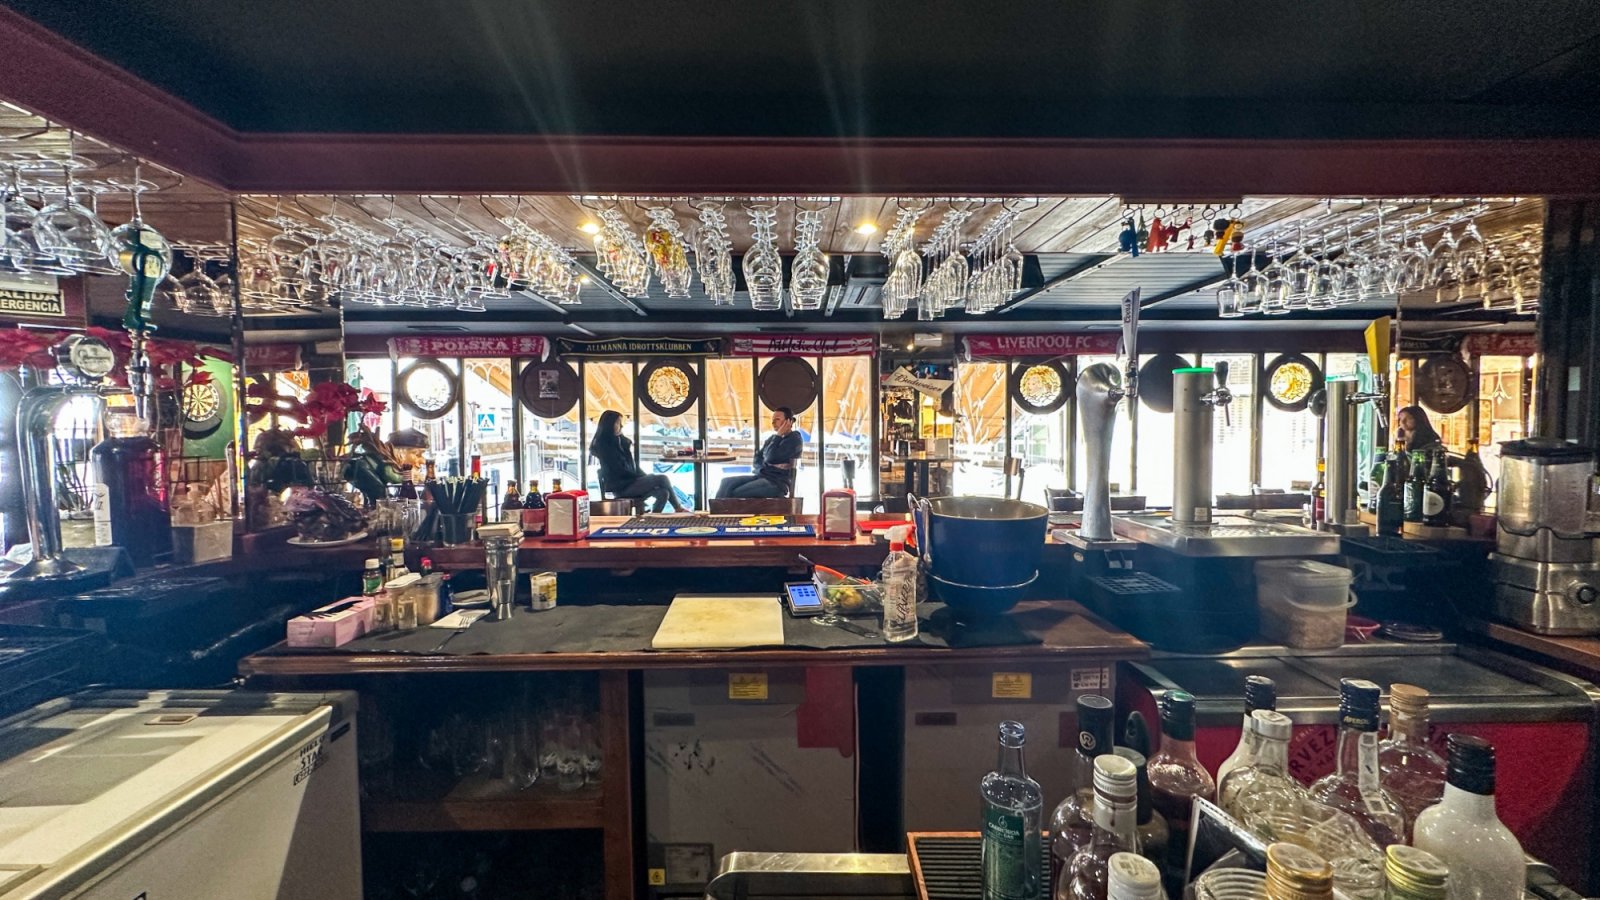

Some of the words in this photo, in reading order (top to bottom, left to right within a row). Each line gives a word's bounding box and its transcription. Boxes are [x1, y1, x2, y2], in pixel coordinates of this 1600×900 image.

[431, 341, 509, 351] POLSKA
[996, 335, 1072, 349] LIVERPOOL
[1075, 335, 1092, 348] FC
[895, 373, 943, 392] Budweiser
